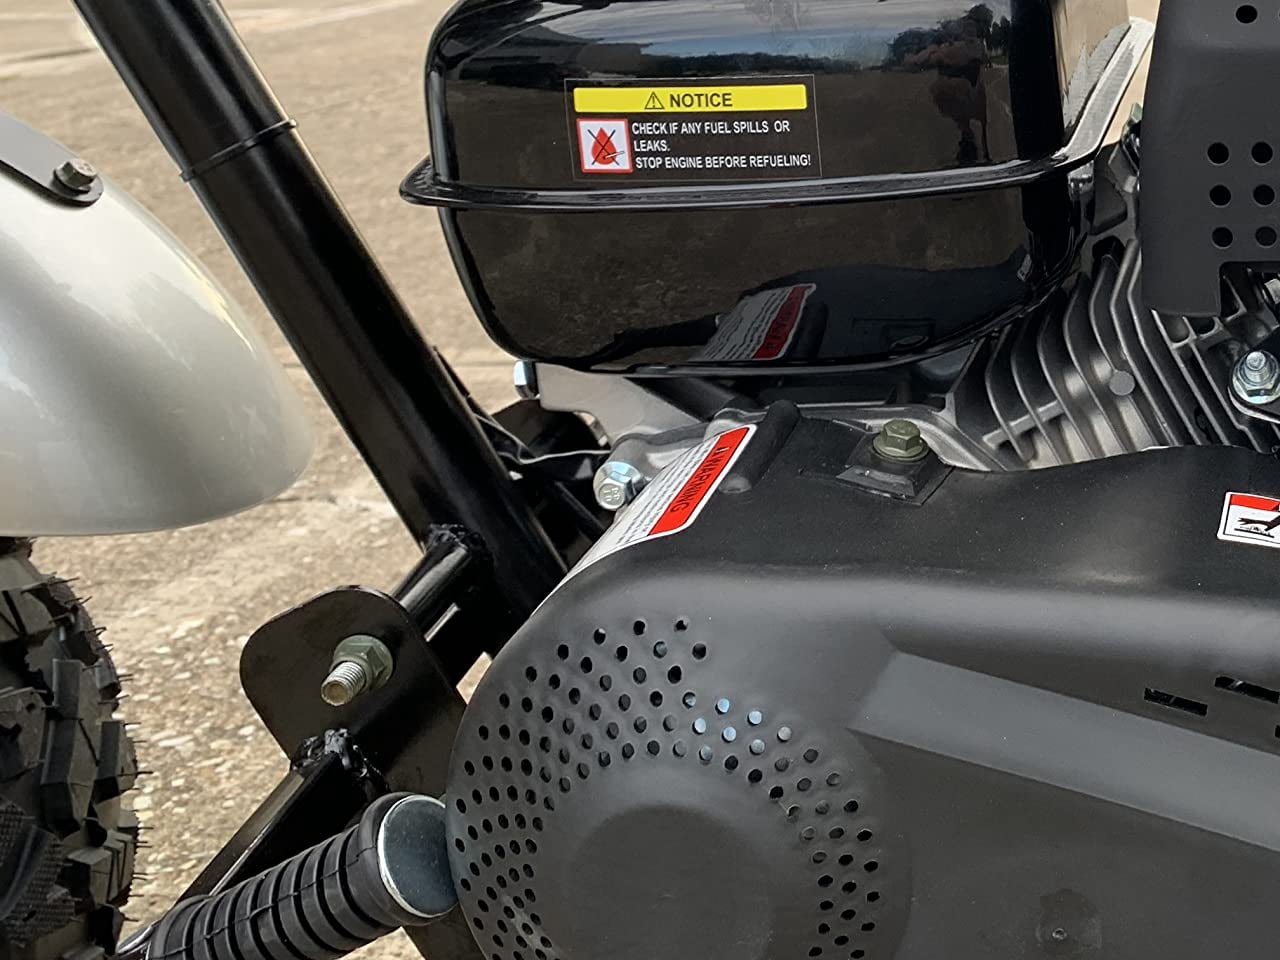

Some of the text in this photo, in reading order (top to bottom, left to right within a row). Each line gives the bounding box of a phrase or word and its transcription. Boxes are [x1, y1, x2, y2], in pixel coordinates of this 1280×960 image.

[670, 92, 733, 108] NOTICE
[632, 120, 790, 135] CHECK IF ANY FUEL SPILLS OR
[634, 139, 671, 152] LEAKS.
[635, 155, 811, 169] STOP ENGINE BEFORE REFUELING!
[670, 456, 721, 513] WARNING
